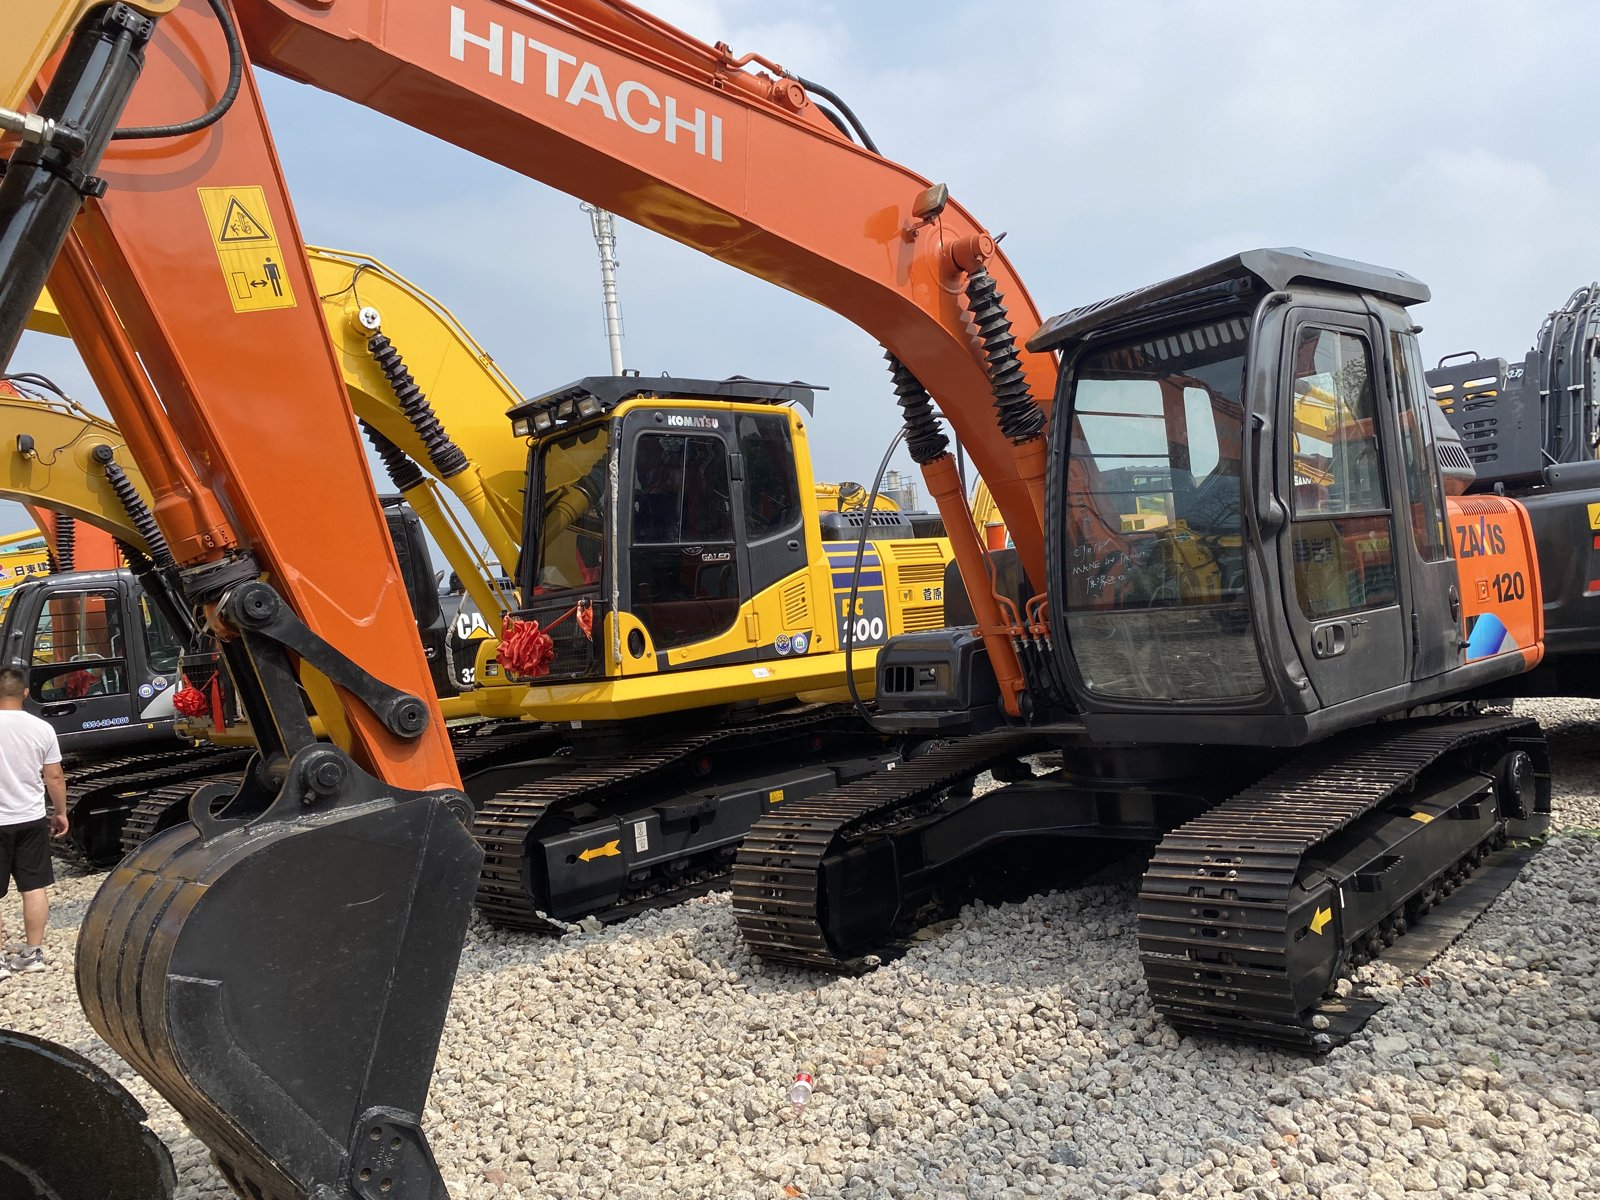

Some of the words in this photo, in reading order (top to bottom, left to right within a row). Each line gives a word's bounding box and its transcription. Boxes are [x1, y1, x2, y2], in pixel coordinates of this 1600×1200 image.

[450, 5, 722, 162] HITACHI
[667, 414, 719, 428] KOMATSU
[1456, 516, 1506, 559] ZAXIS
[701, 552, 730, 562] GALEO
[1492, 571, 1525, 603] 120
[457, 612, 496, 640] CA
[842, 617, 884, 643] 200
